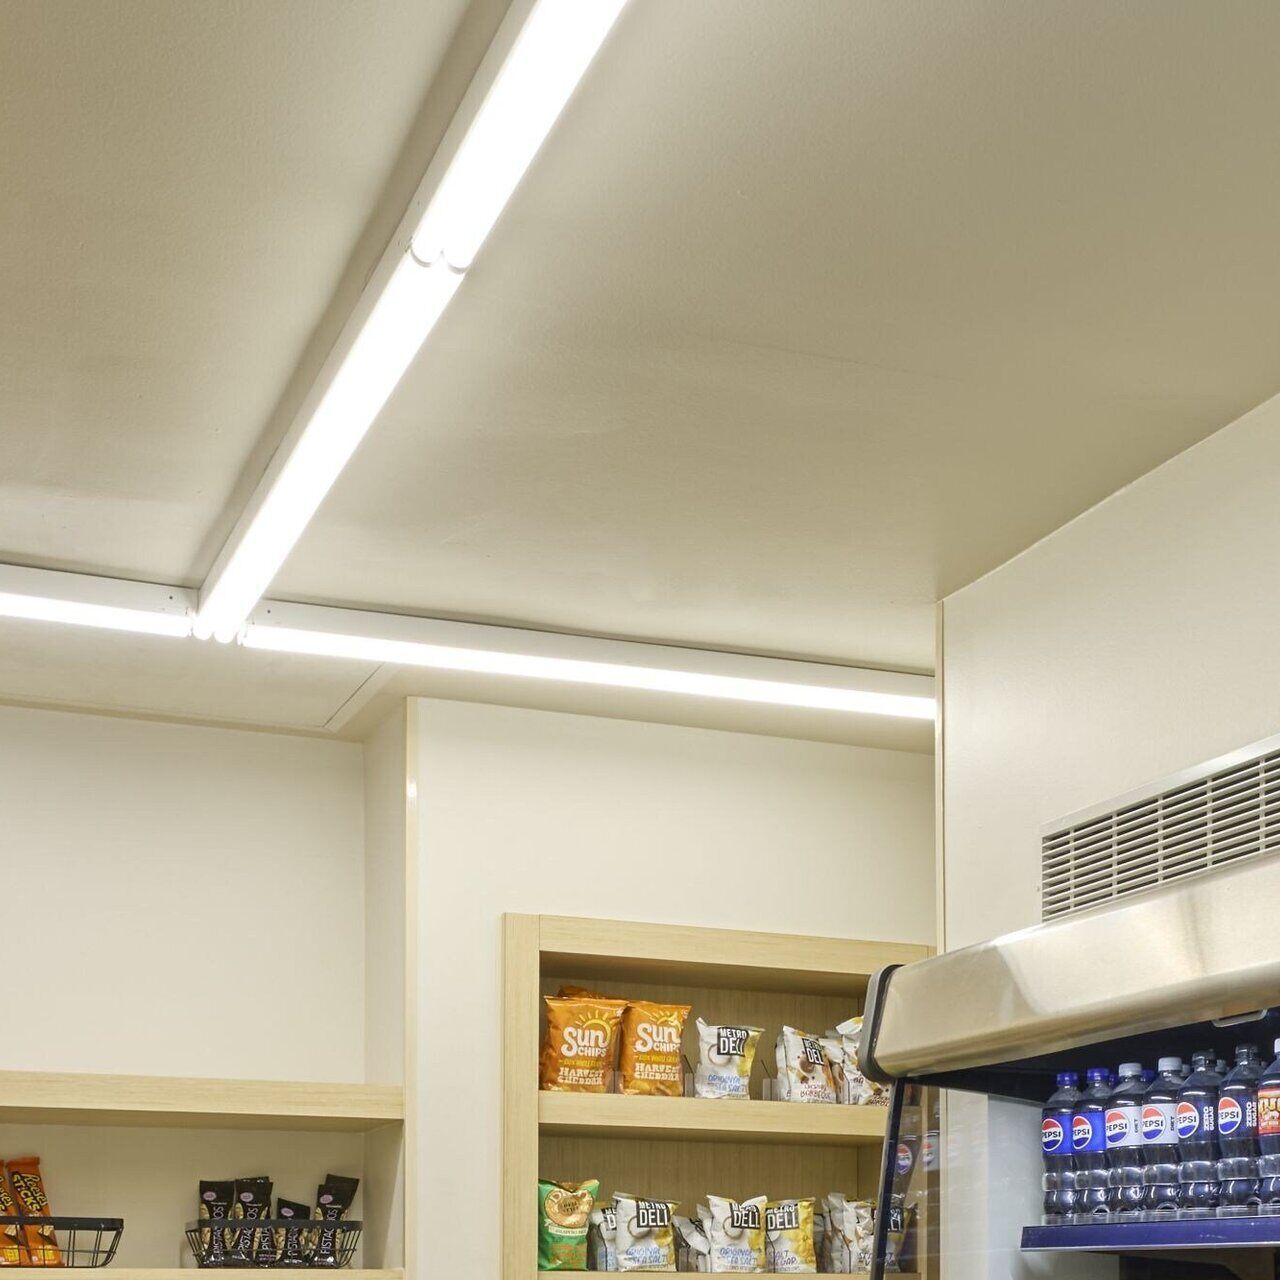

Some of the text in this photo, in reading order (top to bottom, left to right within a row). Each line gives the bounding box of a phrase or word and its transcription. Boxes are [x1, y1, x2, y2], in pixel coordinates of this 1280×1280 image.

[635, 1023, 681, 1053] Sun
[720, 1028, 747, 1038] METRO
[561, 1027, 609, 1057] Sun
[578, 1046, 607, 1058] CHIPS
[559, 1067, 604, 1079] HARVEST
[557, 1076, 603, 1086] CHEDDAR
[639, 1209, 669, 1227] DELI
[767, 1212, 799, 1230] DELI
